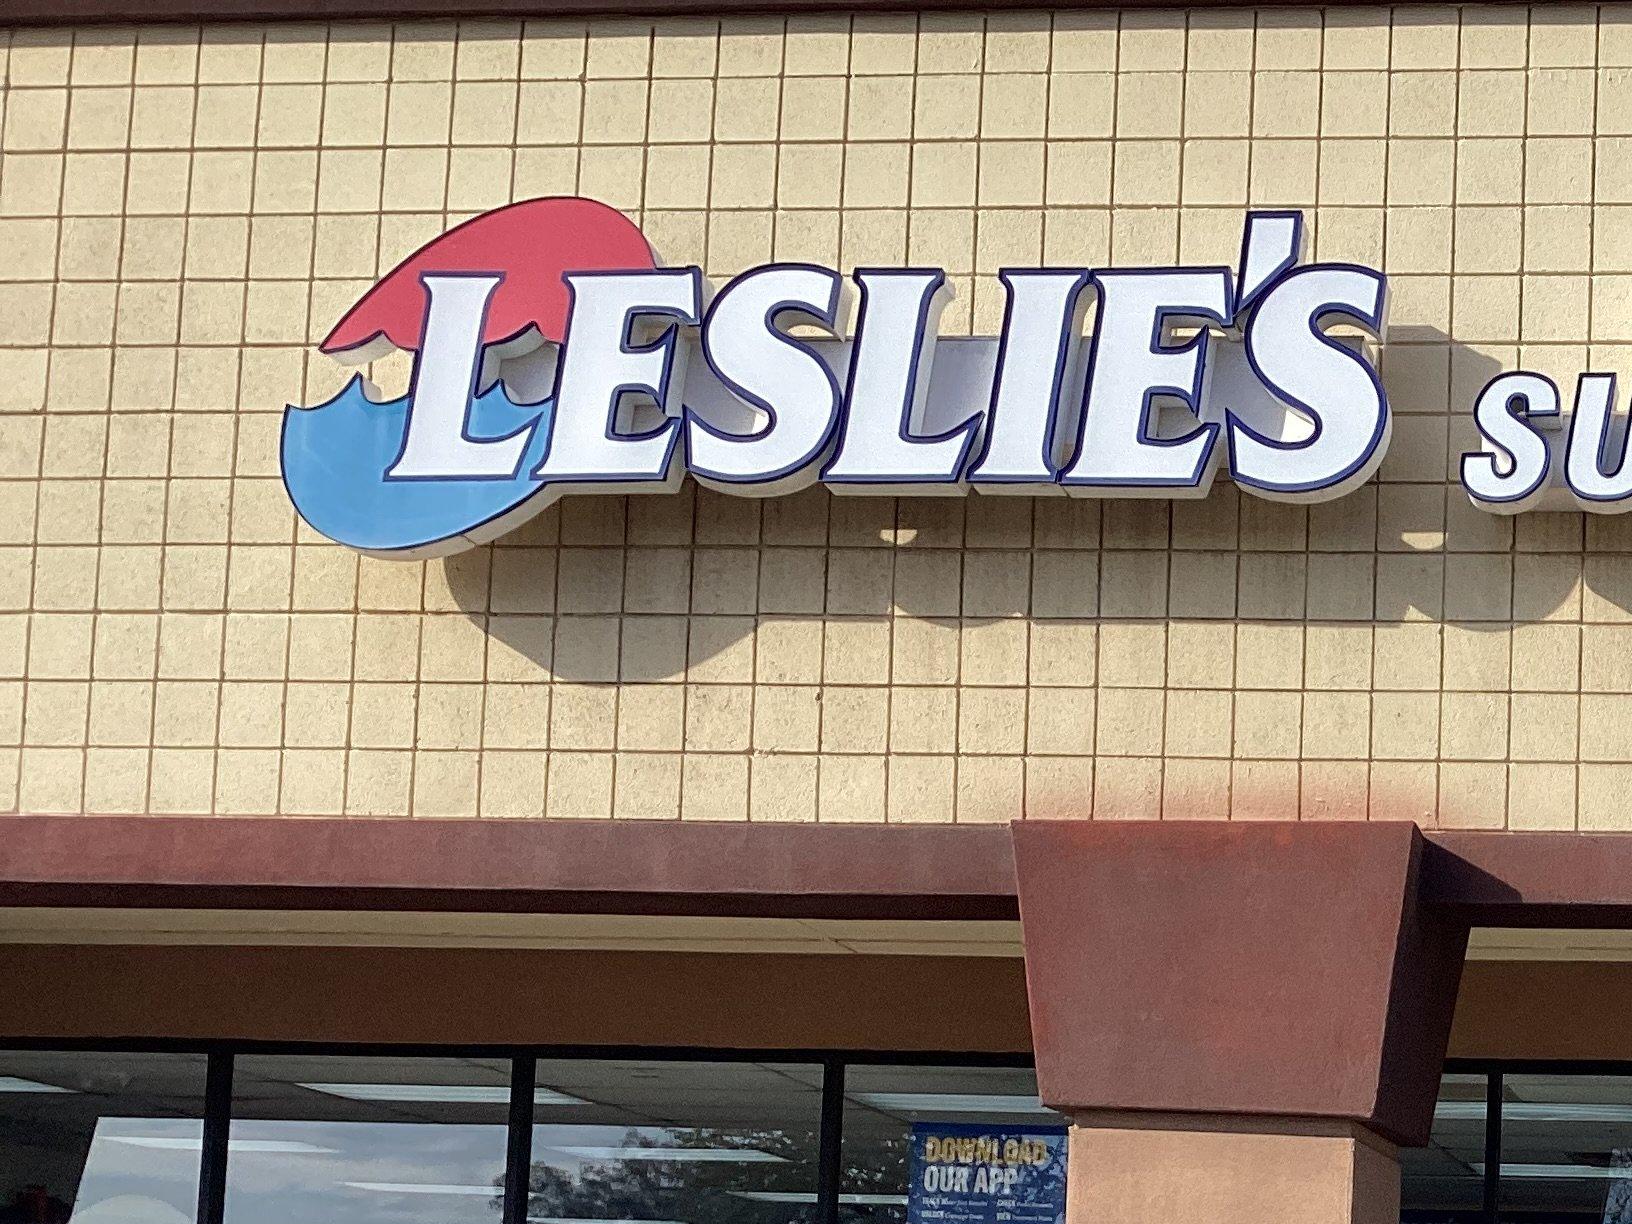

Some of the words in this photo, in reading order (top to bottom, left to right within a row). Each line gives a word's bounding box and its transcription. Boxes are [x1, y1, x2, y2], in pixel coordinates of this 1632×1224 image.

[383, 210, 1389, 494] LESLIE'S
[924, 1135, 1047, 1165] DOWNLOAD
[923, 1165, 969, 1192] OUR
[973, 1166, 1018, 1194] APP
